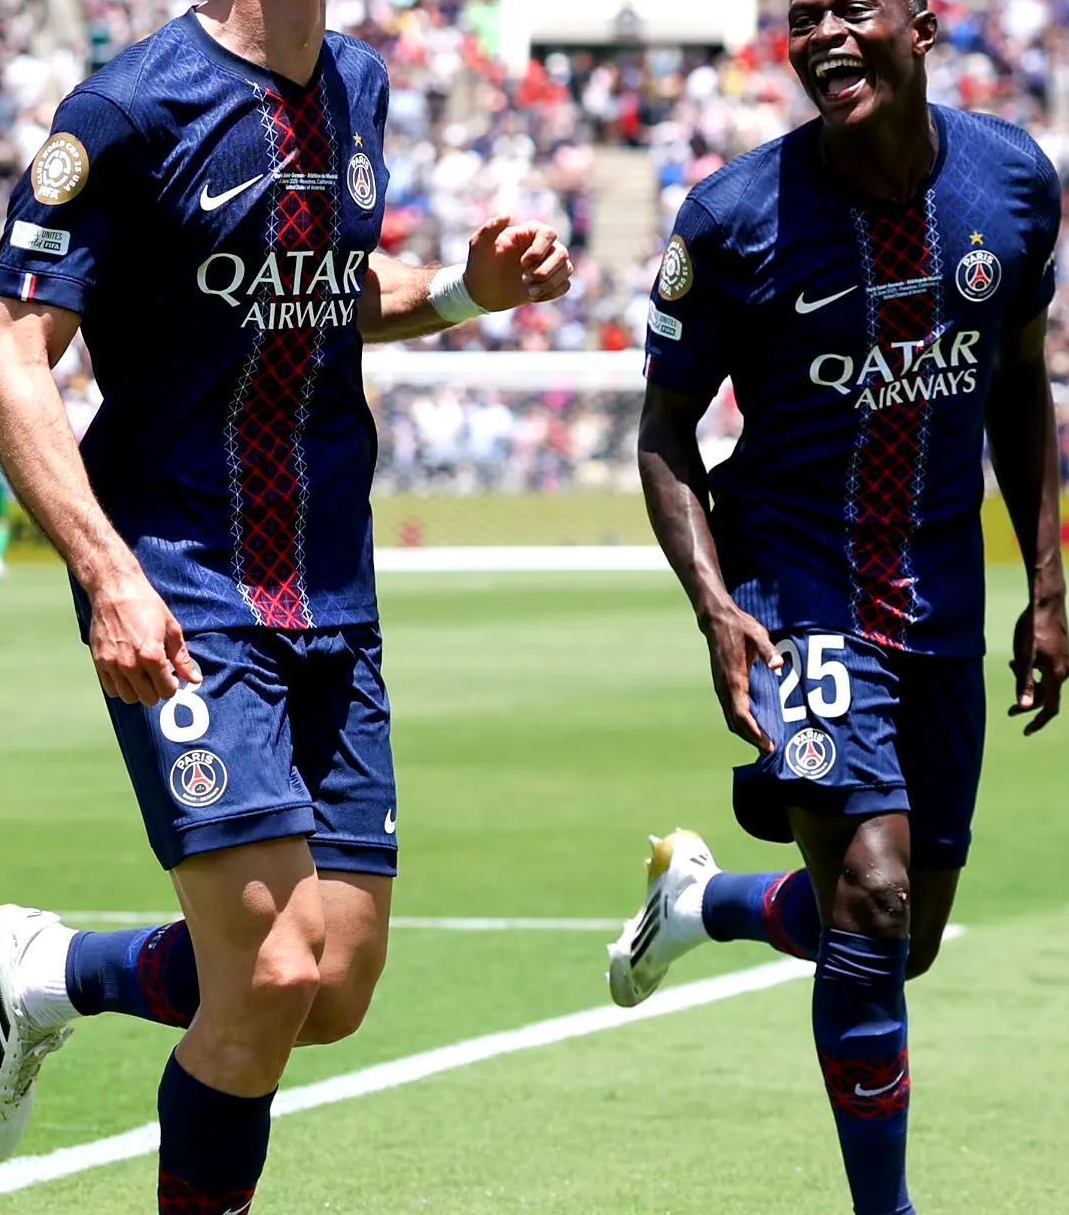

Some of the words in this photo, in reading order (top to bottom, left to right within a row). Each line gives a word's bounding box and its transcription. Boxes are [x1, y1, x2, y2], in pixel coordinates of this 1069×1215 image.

[63, 174, 80, 192] USA
[42, 231, 63, 241] UNITES
[44, 241, 60, 251] FIFA
[962, 253, 994, 267] PARIS
[197, 250, 365, 307] QATAR
[809, 330, 981, 395] QATAR
[854, 368, 978, 411] AIRWAYS
[775, 635, 851, 723] 25
[793, 731, 824, 746] PARIS
[176, 753, 214, 770] PARIS
